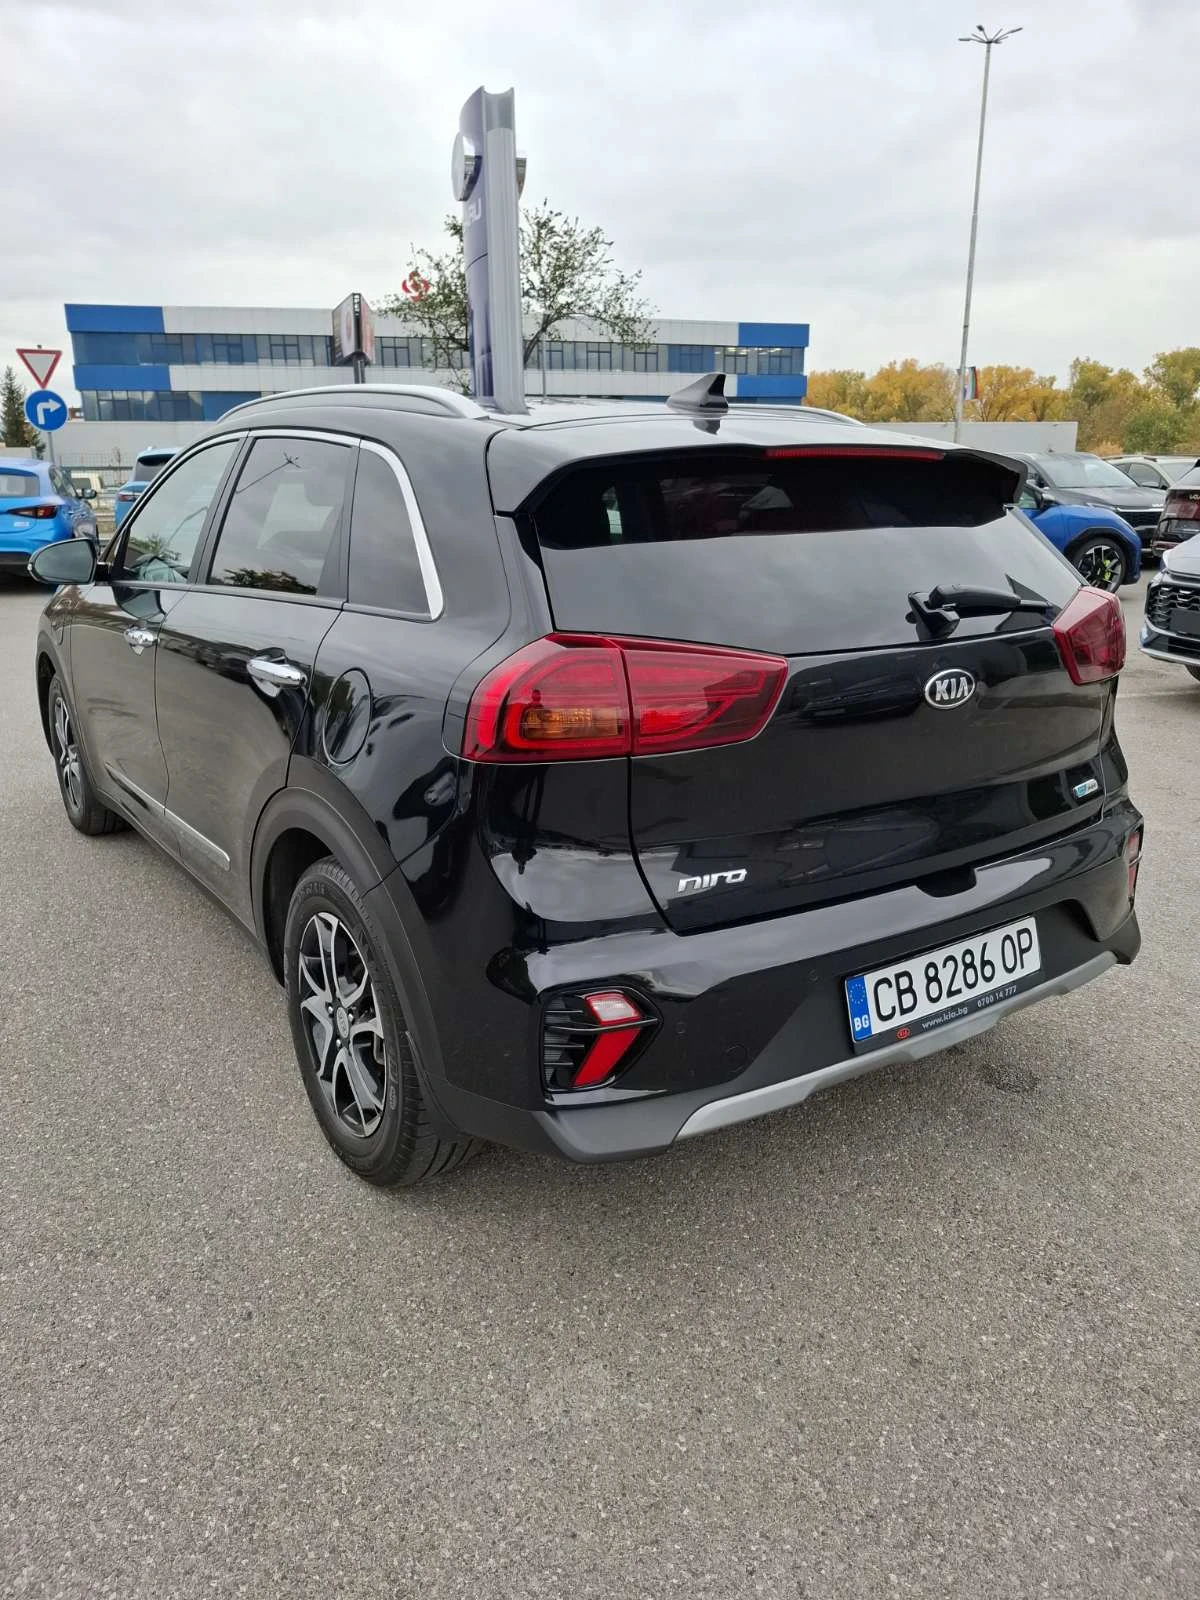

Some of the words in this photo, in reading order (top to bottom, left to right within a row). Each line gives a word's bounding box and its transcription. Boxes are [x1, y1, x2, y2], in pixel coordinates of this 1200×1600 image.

[935, 676, 969, 701] KIA
[678, 868, 747, 892] niro
[873, 970, 918, 1022] CB
[924, 942, 996, 1004] 8286
[1001, 927, 1033, 974] OP
[921, 1006, 968, 1030] www.kia.bg
[977, 994, 994, 1007] 0700
[995, 990, 1003, 1000] 14
[1005, 985, 1017, 997] 777
[853, 1014, 870, 1031] BG
